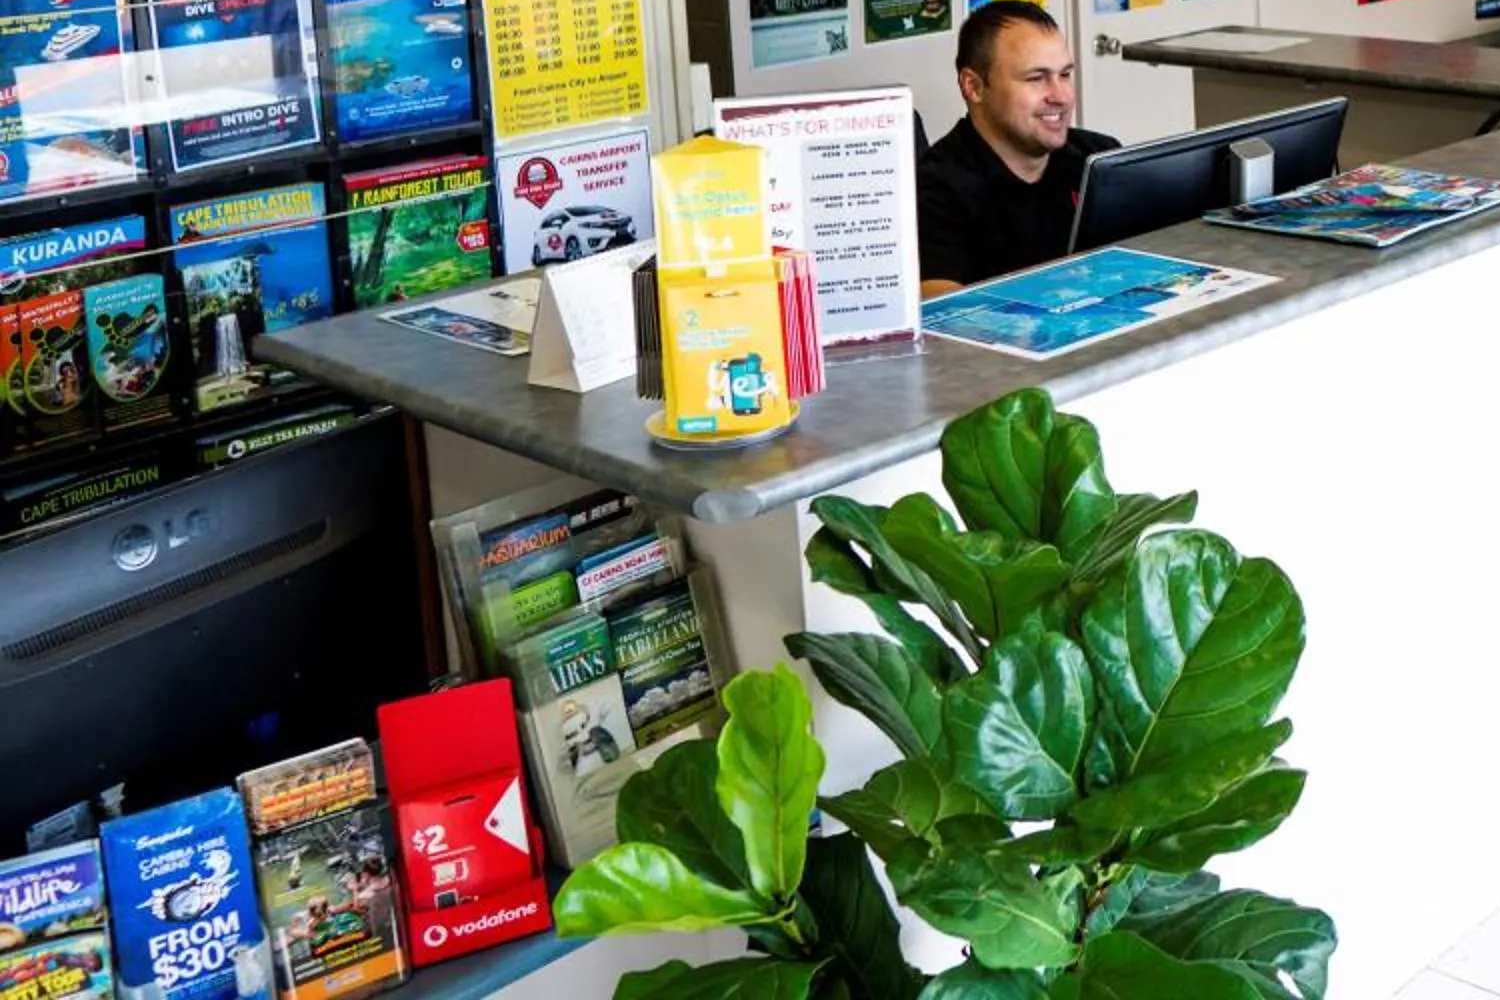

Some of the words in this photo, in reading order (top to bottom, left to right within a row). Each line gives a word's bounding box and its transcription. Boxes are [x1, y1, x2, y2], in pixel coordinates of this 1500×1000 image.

[185, 1, 215, 17] DIVE
[221, 109, 264, 128] INTRO
[267, 101, 300, 117] DIVE
[724, 121, 791, 140] WHAT'S
[559, 152, 599, 166] CAIRNS
[599, 143, 642, 158] AIRPORT
[576, 160, 628, 178] TRANSFER
[363, 178, 439, 206] RAINFOREST
[442, 169, 482, 191] TOURS
[583, 176, 626, 191] SERVICE
[177, 206, 214, 227] CAPE
[214, 190, 313, 219] TRIBULATION
[12, 227, 127, 265] KURANDA
[20, 497, 60, 524] CAPE
[60, 464, 160, 509] TRIBULATION
[411, 824, 449, 855] $2
[138, 845, 195, 871] CAMERA
[140, 860, 192, 881] CAIRNS
[451, 902, 538, 937] vodafone
[148, 909, 241, 960] FROM
[153, 939, 226, 989] $30
